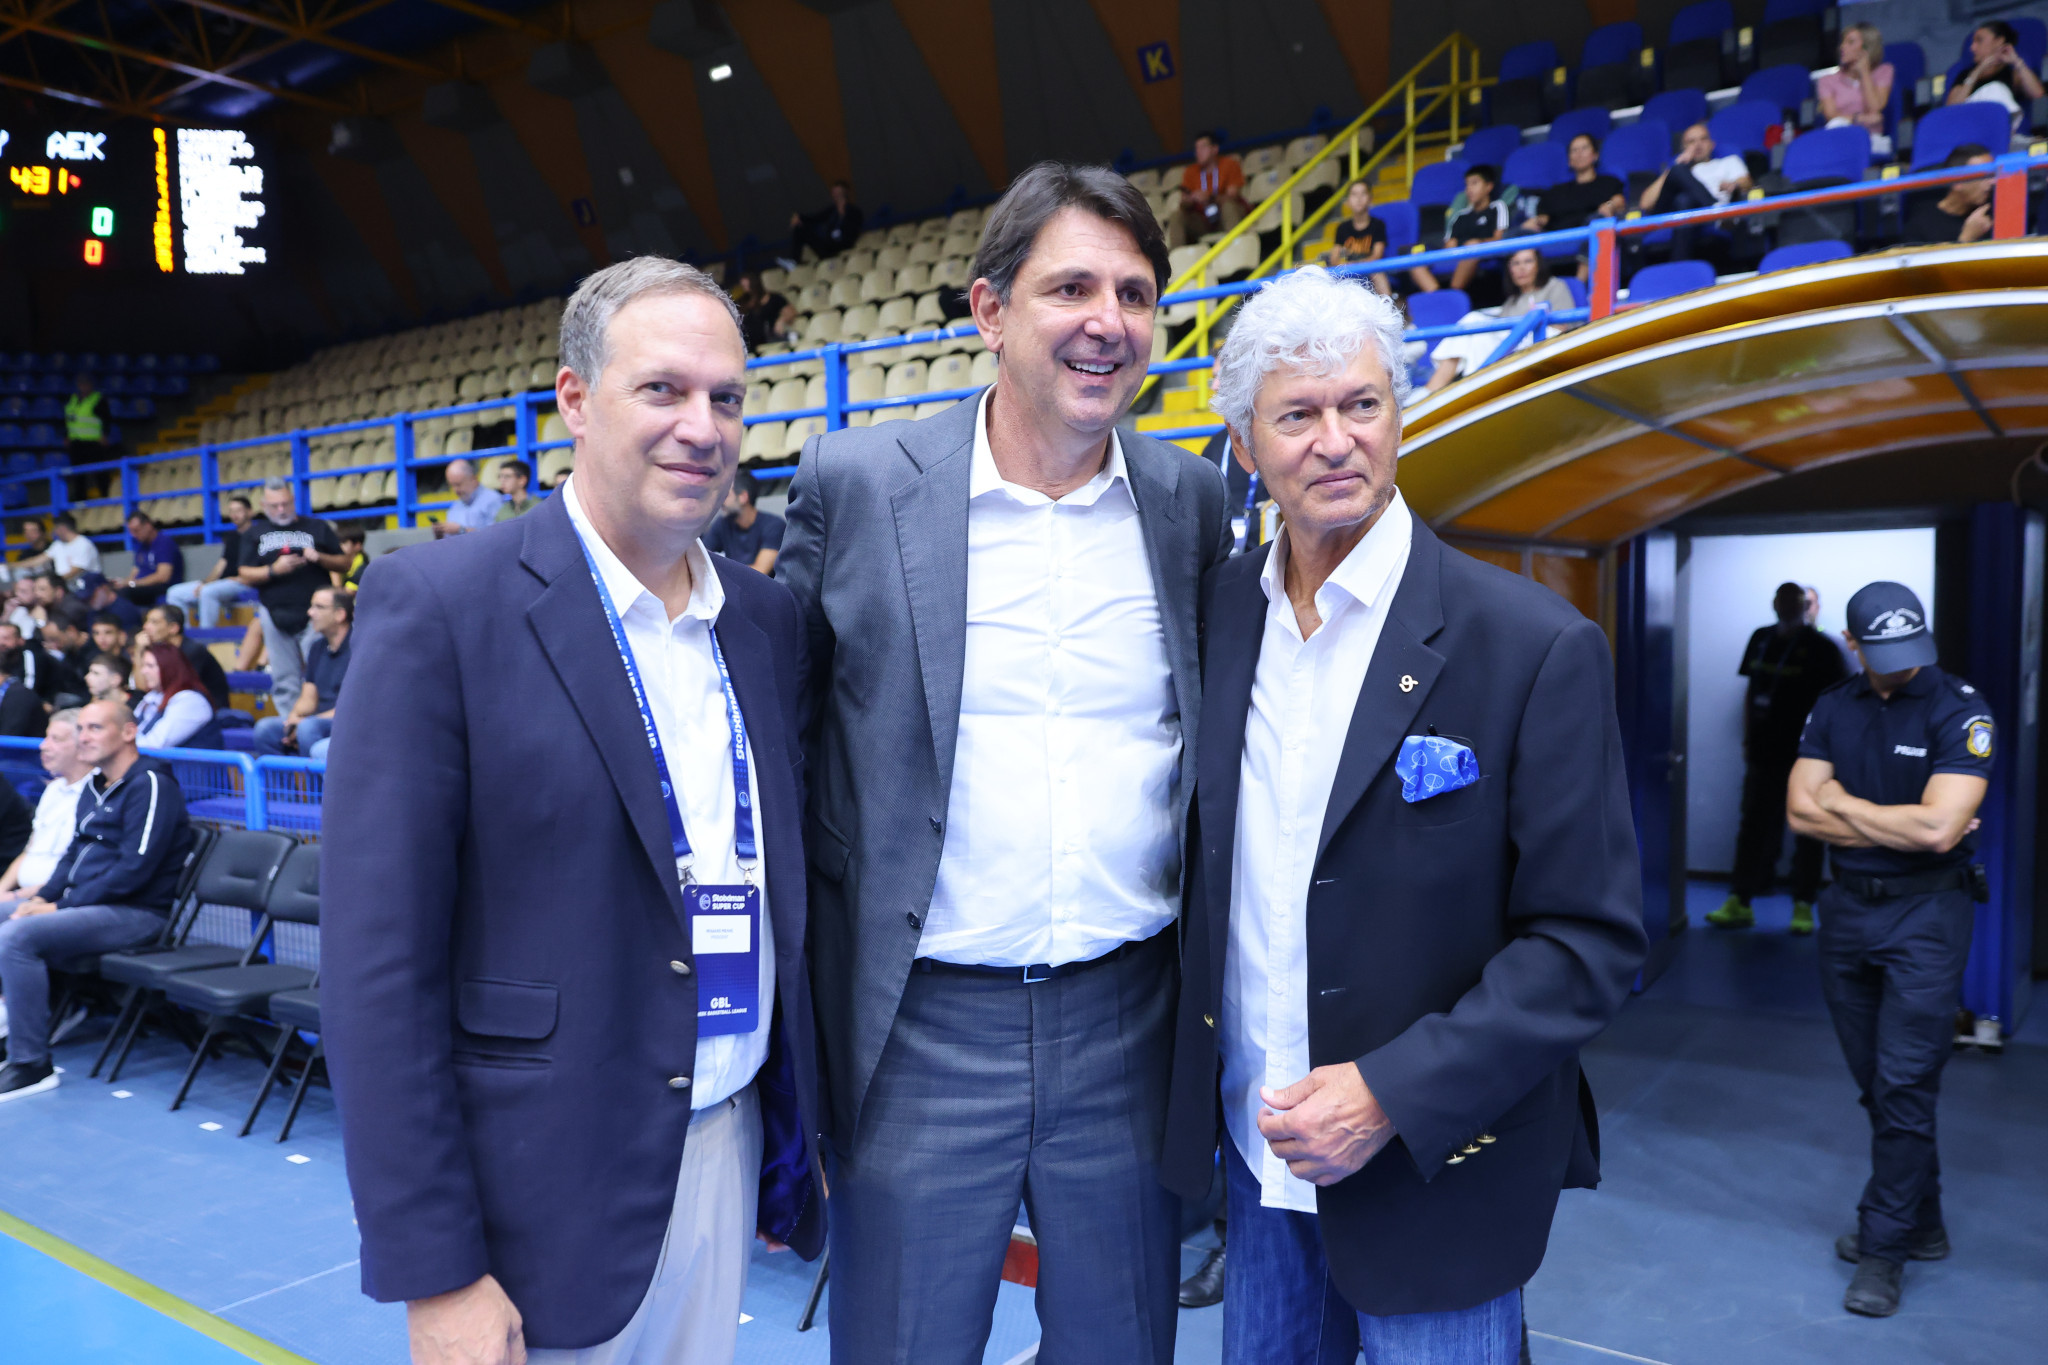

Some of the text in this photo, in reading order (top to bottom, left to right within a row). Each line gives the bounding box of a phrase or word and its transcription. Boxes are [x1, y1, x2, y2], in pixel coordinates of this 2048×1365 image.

[1145, 47, 1169, 78] K
[46, 130, 107, 161] AEK
[92, 207, 113, 236] 0
[84, 239, 103, 265] 0
[711, 902, 746, 910] SUPER CUP
[710, 996, 732, 1010] GBL
